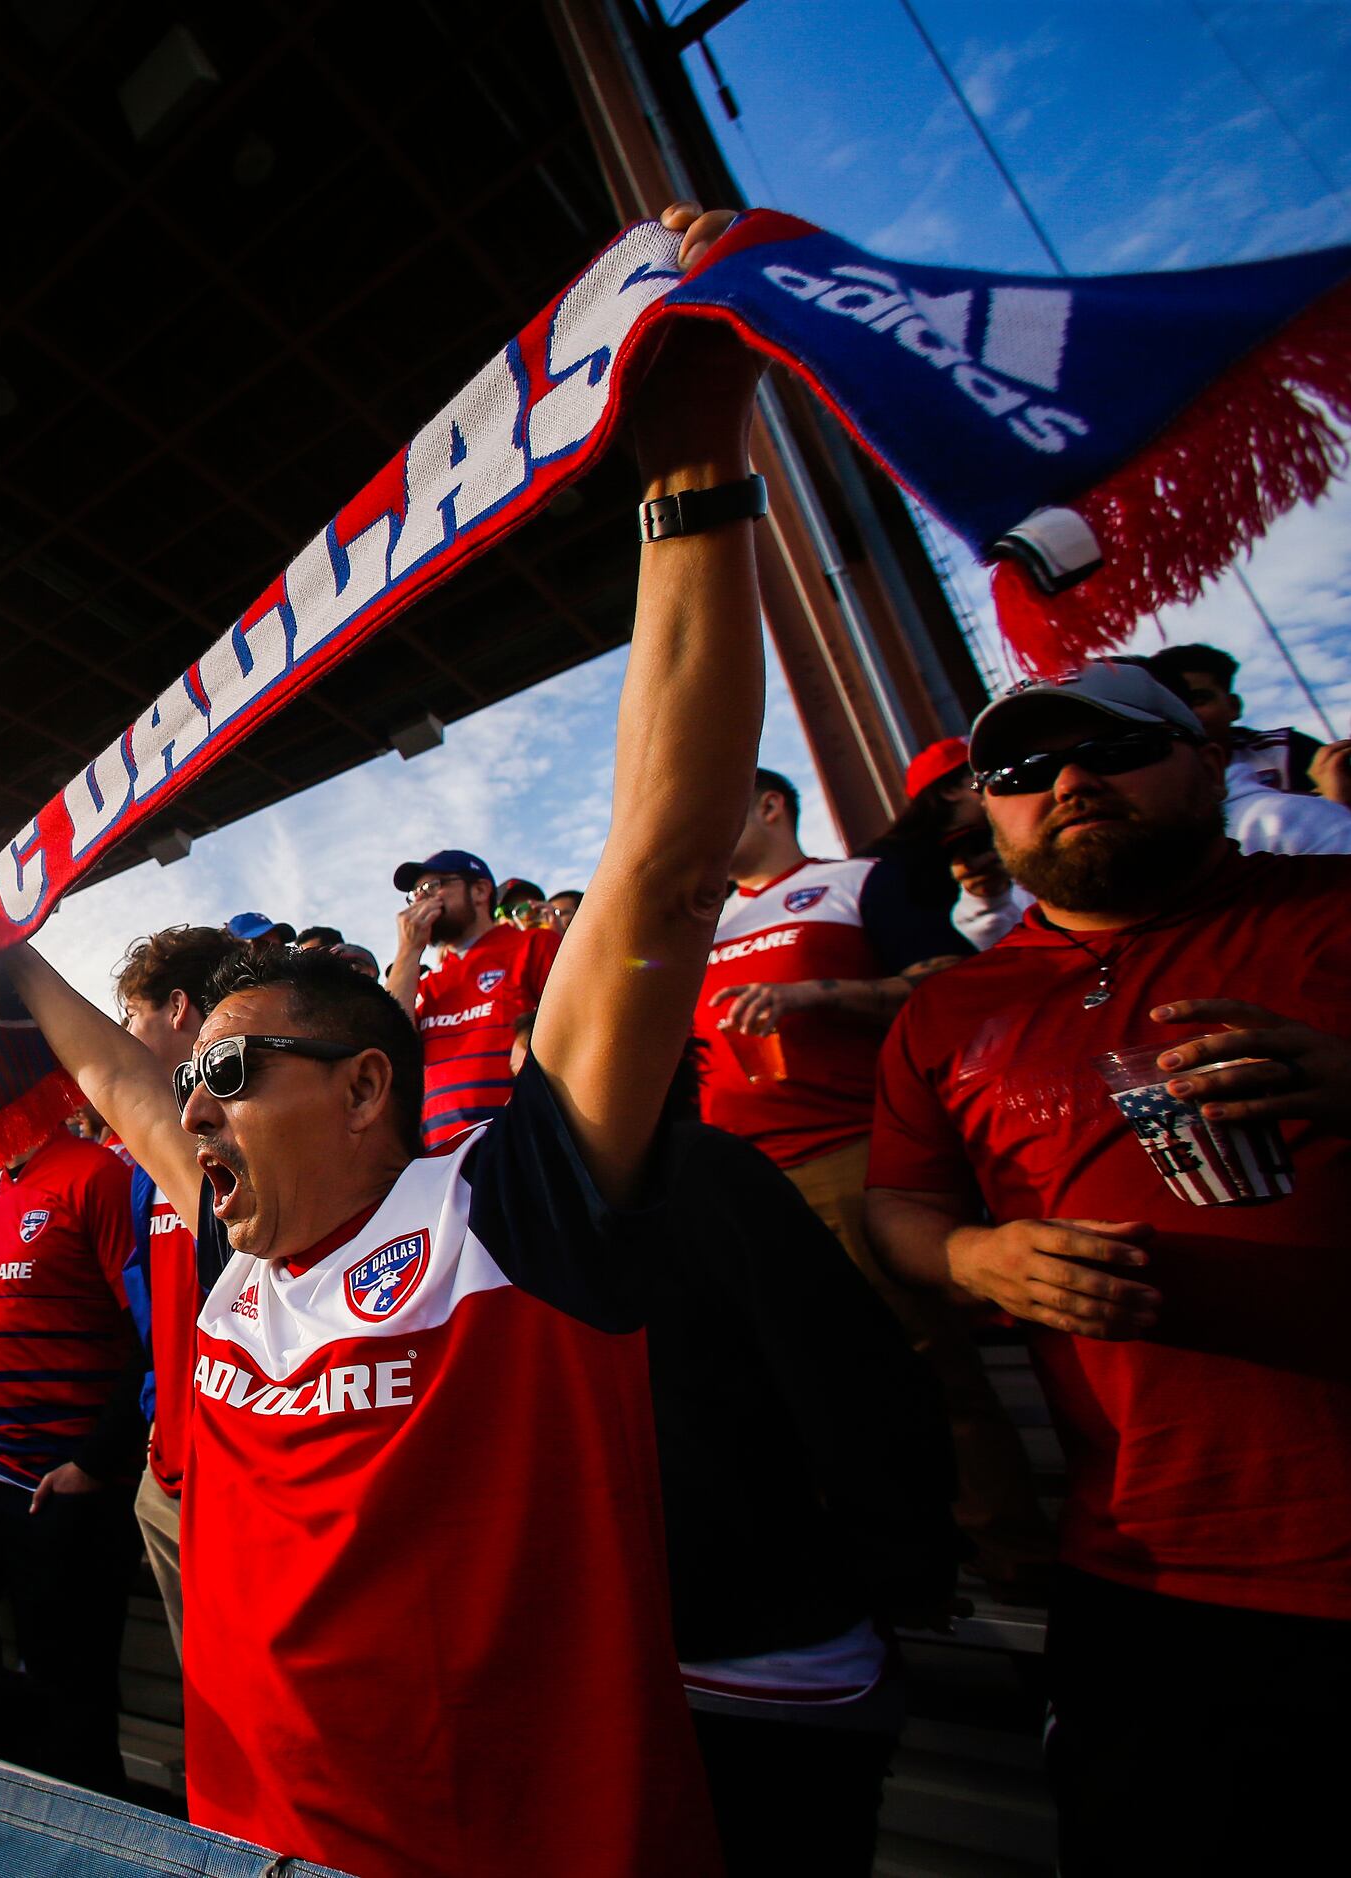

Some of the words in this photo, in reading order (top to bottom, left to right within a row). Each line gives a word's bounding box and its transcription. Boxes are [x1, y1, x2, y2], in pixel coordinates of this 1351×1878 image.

[761, 264, 1090, 454] adidas
[63, 219, 686, 859] DALLAS
[707, 929, 800, 965] VOCARE
[354, 1264, 368, 1287] FC
[371, 1239, 418, 1271] DALLAS
[194, 1354, 415, 1417] ADVOCARE
